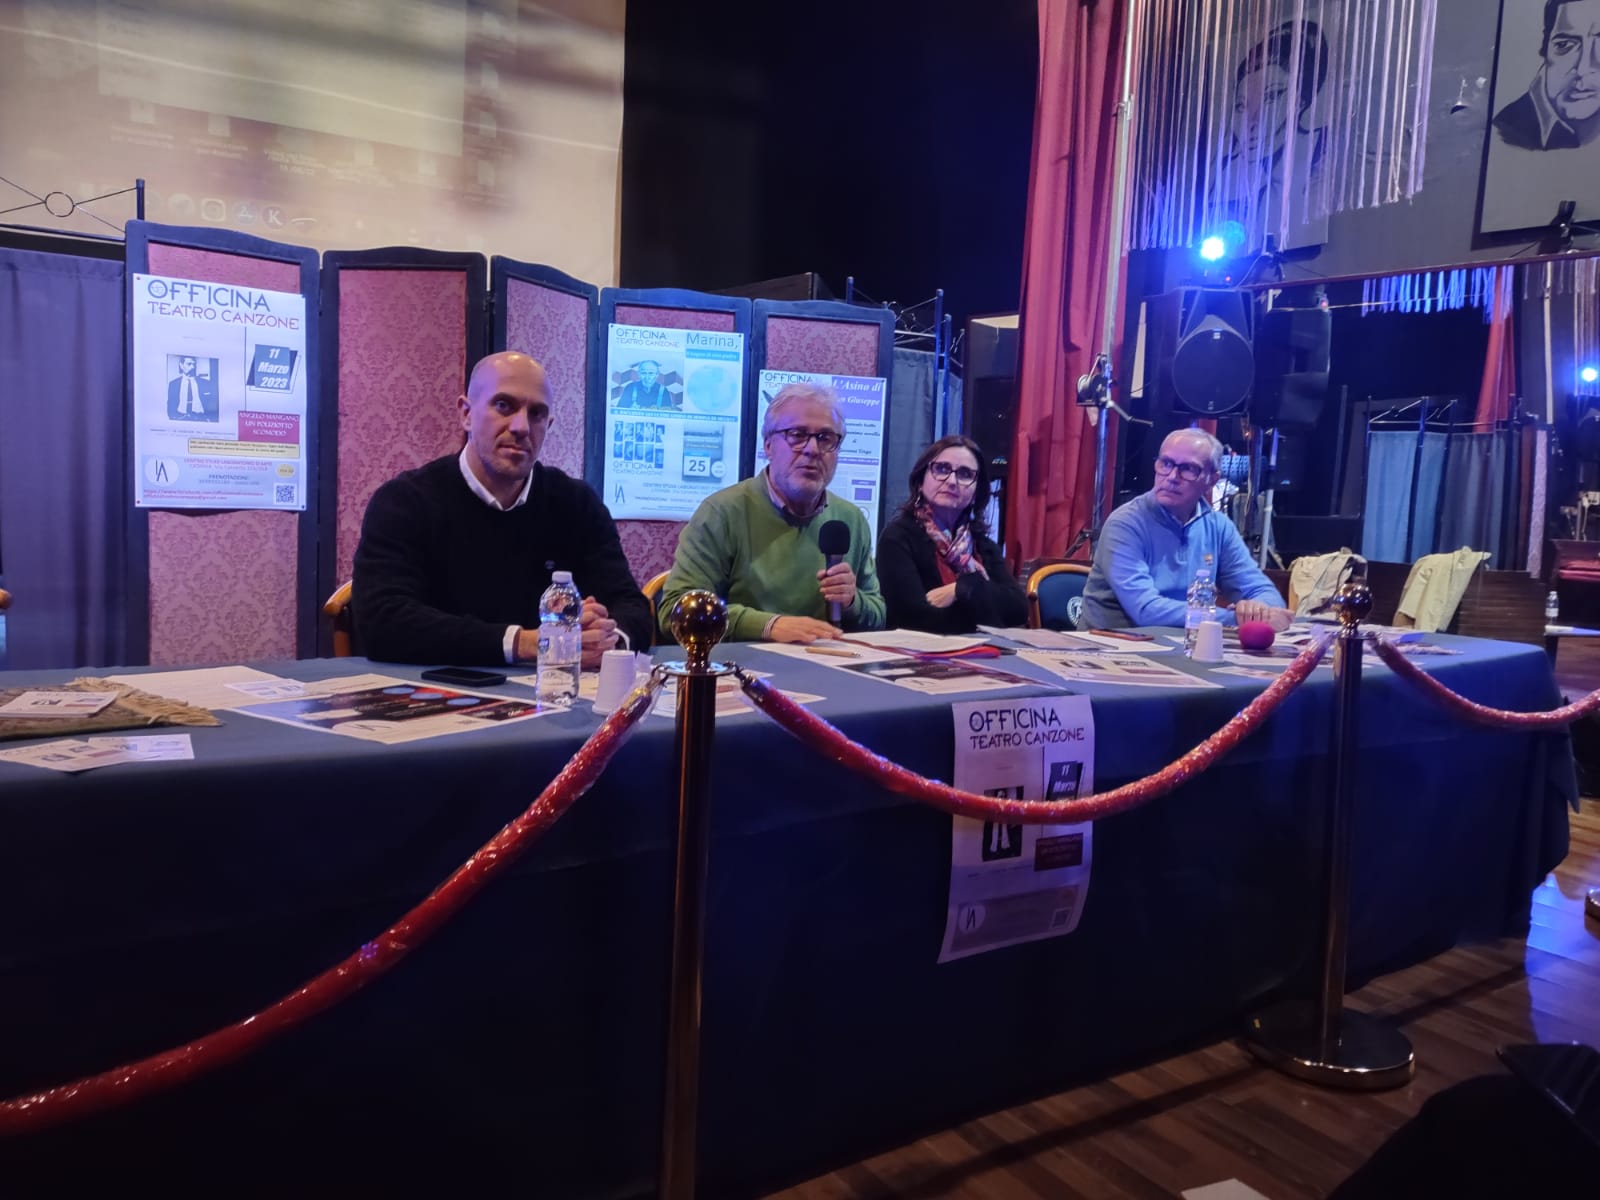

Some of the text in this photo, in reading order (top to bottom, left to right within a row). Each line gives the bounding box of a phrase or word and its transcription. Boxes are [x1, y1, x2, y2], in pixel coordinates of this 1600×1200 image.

[148, 279, 270, 312] OFFICINA
[147, 301, 300, 330] TEATRO CANZONE
[616, 328, 667, 340] OFFICINA
[616, 337, 680, 348] TEATRO CANZONE
[686, 333, 739, 349] Marina,
[269, 348, 281, 359] 11
[257, 362, 290, 374] Marzo
[260, 376, 288, 388] 2023
[765, 372, 813, 384] OFFICINA
[832, 379, 881, 392] L'Asino di
[847, 395, 881, 407] Giuseppe
[613, 461, 653, 470] OFFICINA
[689, 459, 706, 473] 25
[969, 707, 1062, 733] OFFICINA
[969, 727, 1085, 750] TEATRO CANZONE
[1061, 764, 1070, 777] 11
